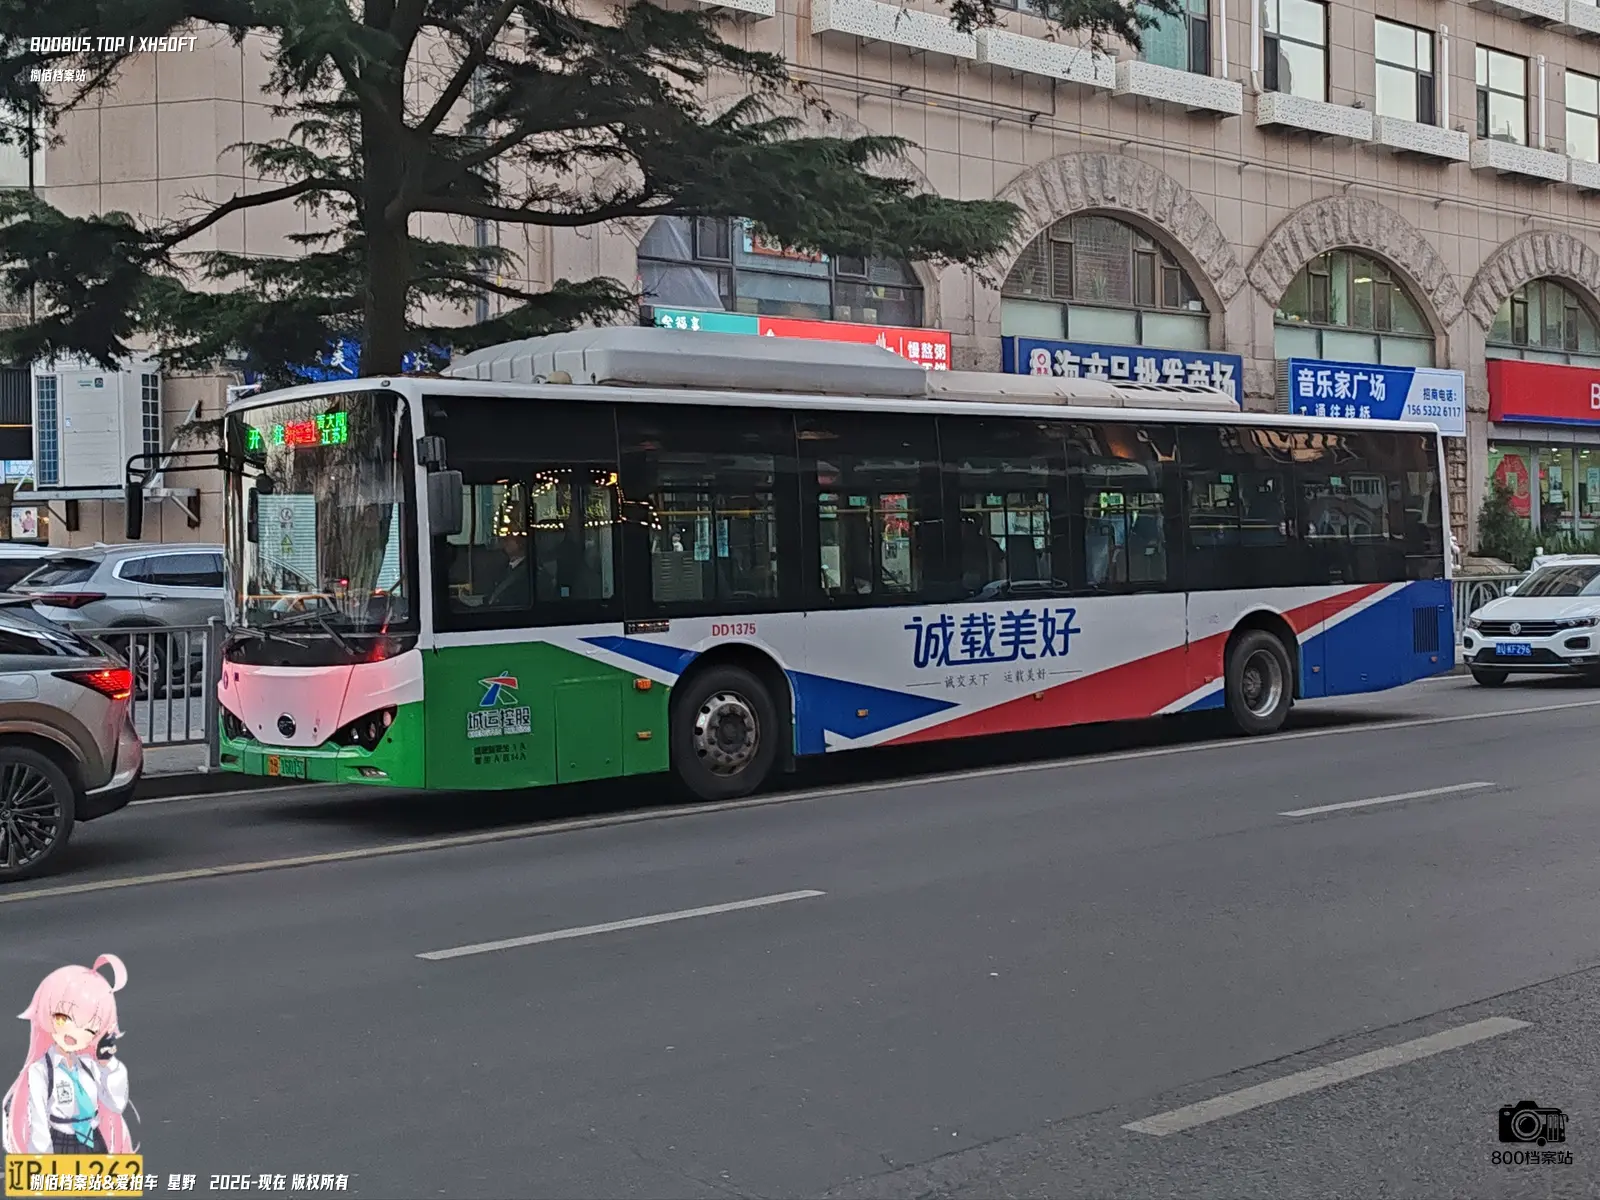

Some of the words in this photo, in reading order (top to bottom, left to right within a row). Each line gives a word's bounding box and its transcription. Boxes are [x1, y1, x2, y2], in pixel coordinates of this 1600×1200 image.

[1297, 368, 1386, 402] 音乐家广场
[1407, 404, 1422, 416] 156
[1423, 405, 1442, 417] 5322
[1443, 406, 1461, 418] 6117
[712, 623, 757, 637] DD1375
[904, 607, 1081, 668] 诚载美好
